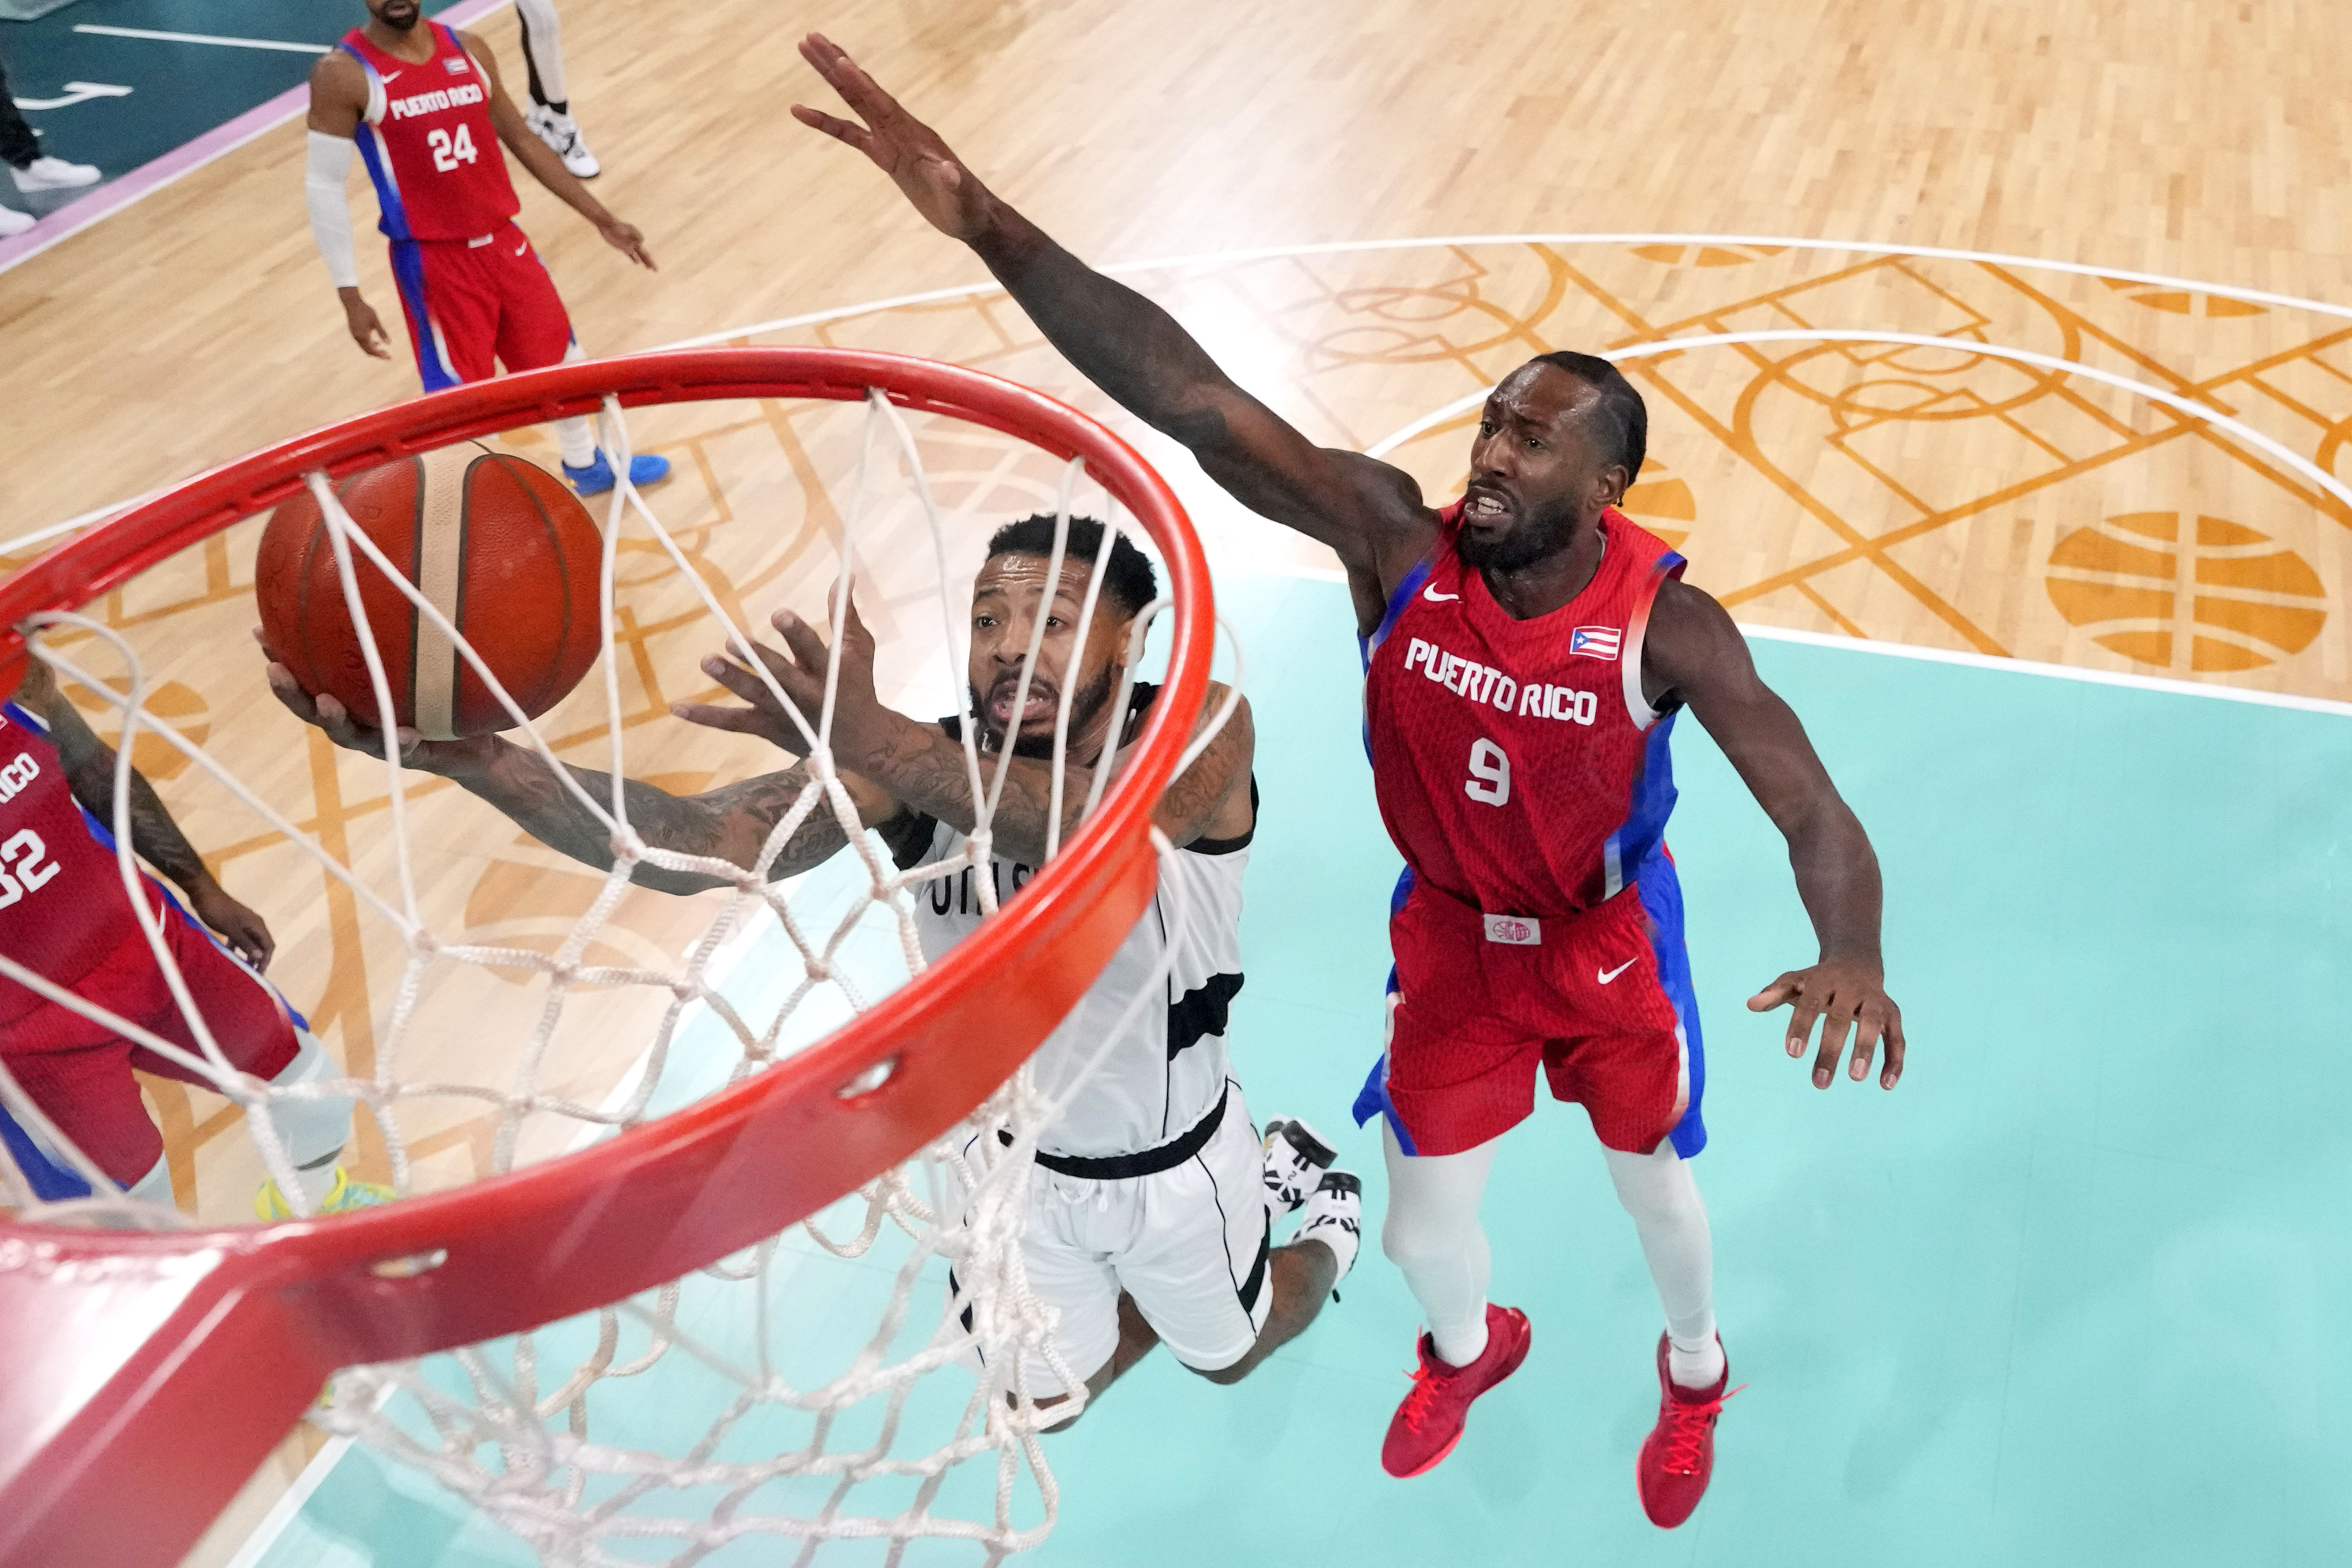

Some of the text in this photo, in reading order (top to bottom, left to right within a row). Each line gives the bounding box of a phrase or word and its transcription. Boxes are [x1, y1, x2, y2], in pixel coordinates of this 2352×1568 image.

[427, 123, 478, 172] 24
[1405, 637, 1598, 726] PUERTO RICO
[1465, 737, 1510, 807] 9
